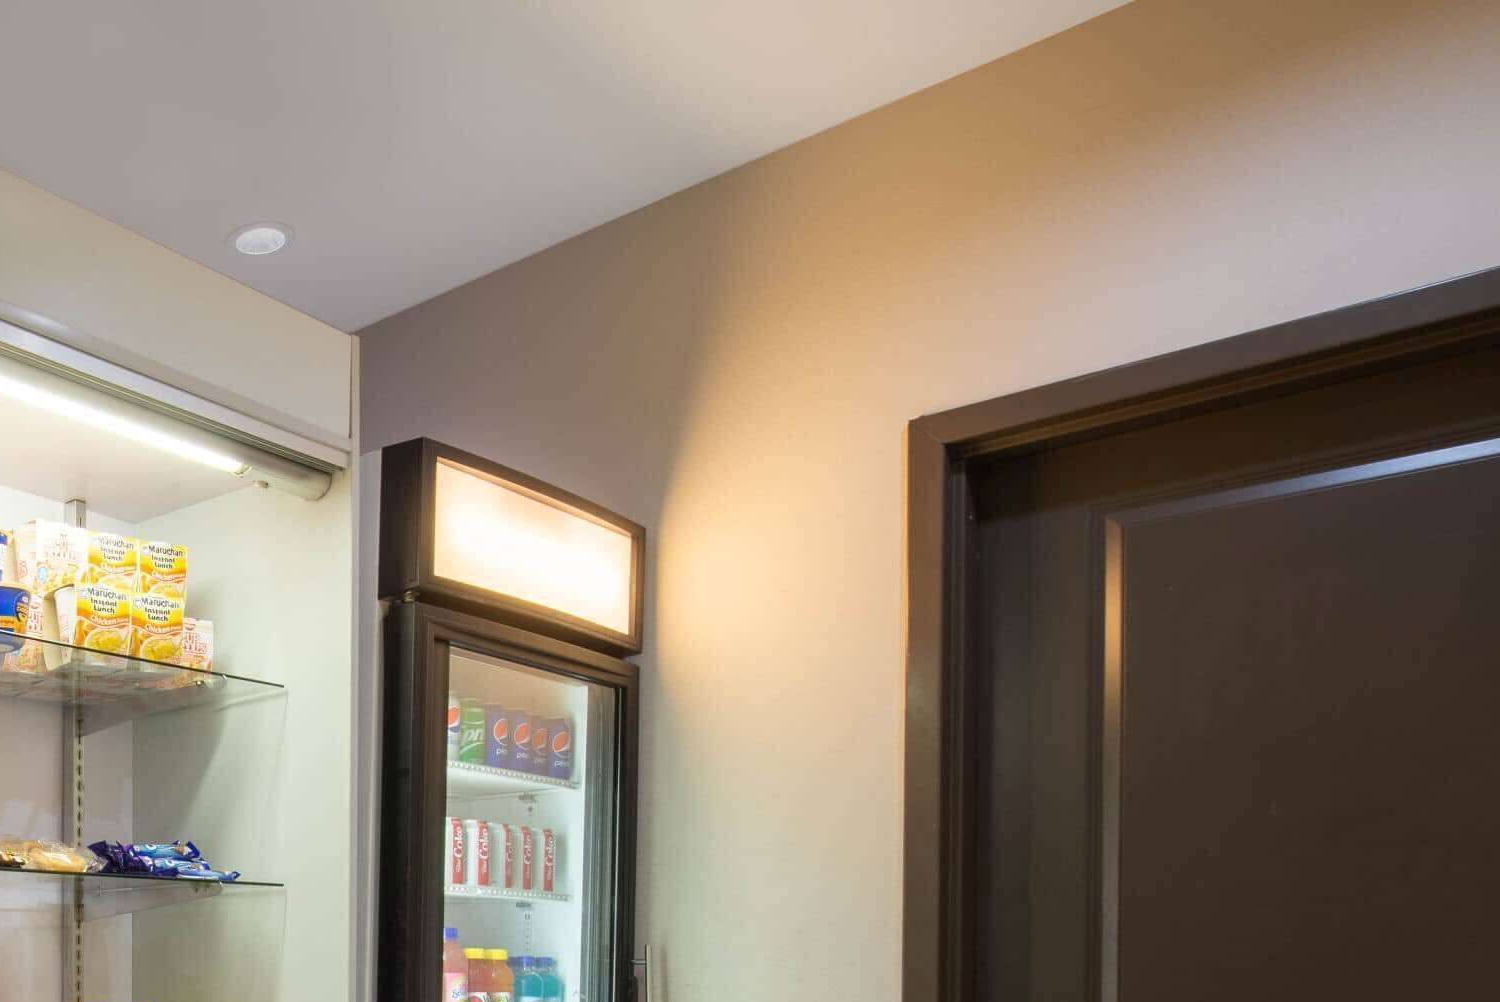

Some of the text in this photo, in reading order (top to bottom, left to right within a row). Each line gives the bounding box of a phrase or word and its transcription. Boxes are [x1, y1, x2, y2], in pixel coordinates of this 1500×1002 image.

[148, 545, 184, 557] Maruchan
[87, 587, 127, 601] Maruchan
[141, 597, 181, 609] Maruchan
[93, 605, 116, 614] Lunch
[147, 614, 169, 622] Lunch
